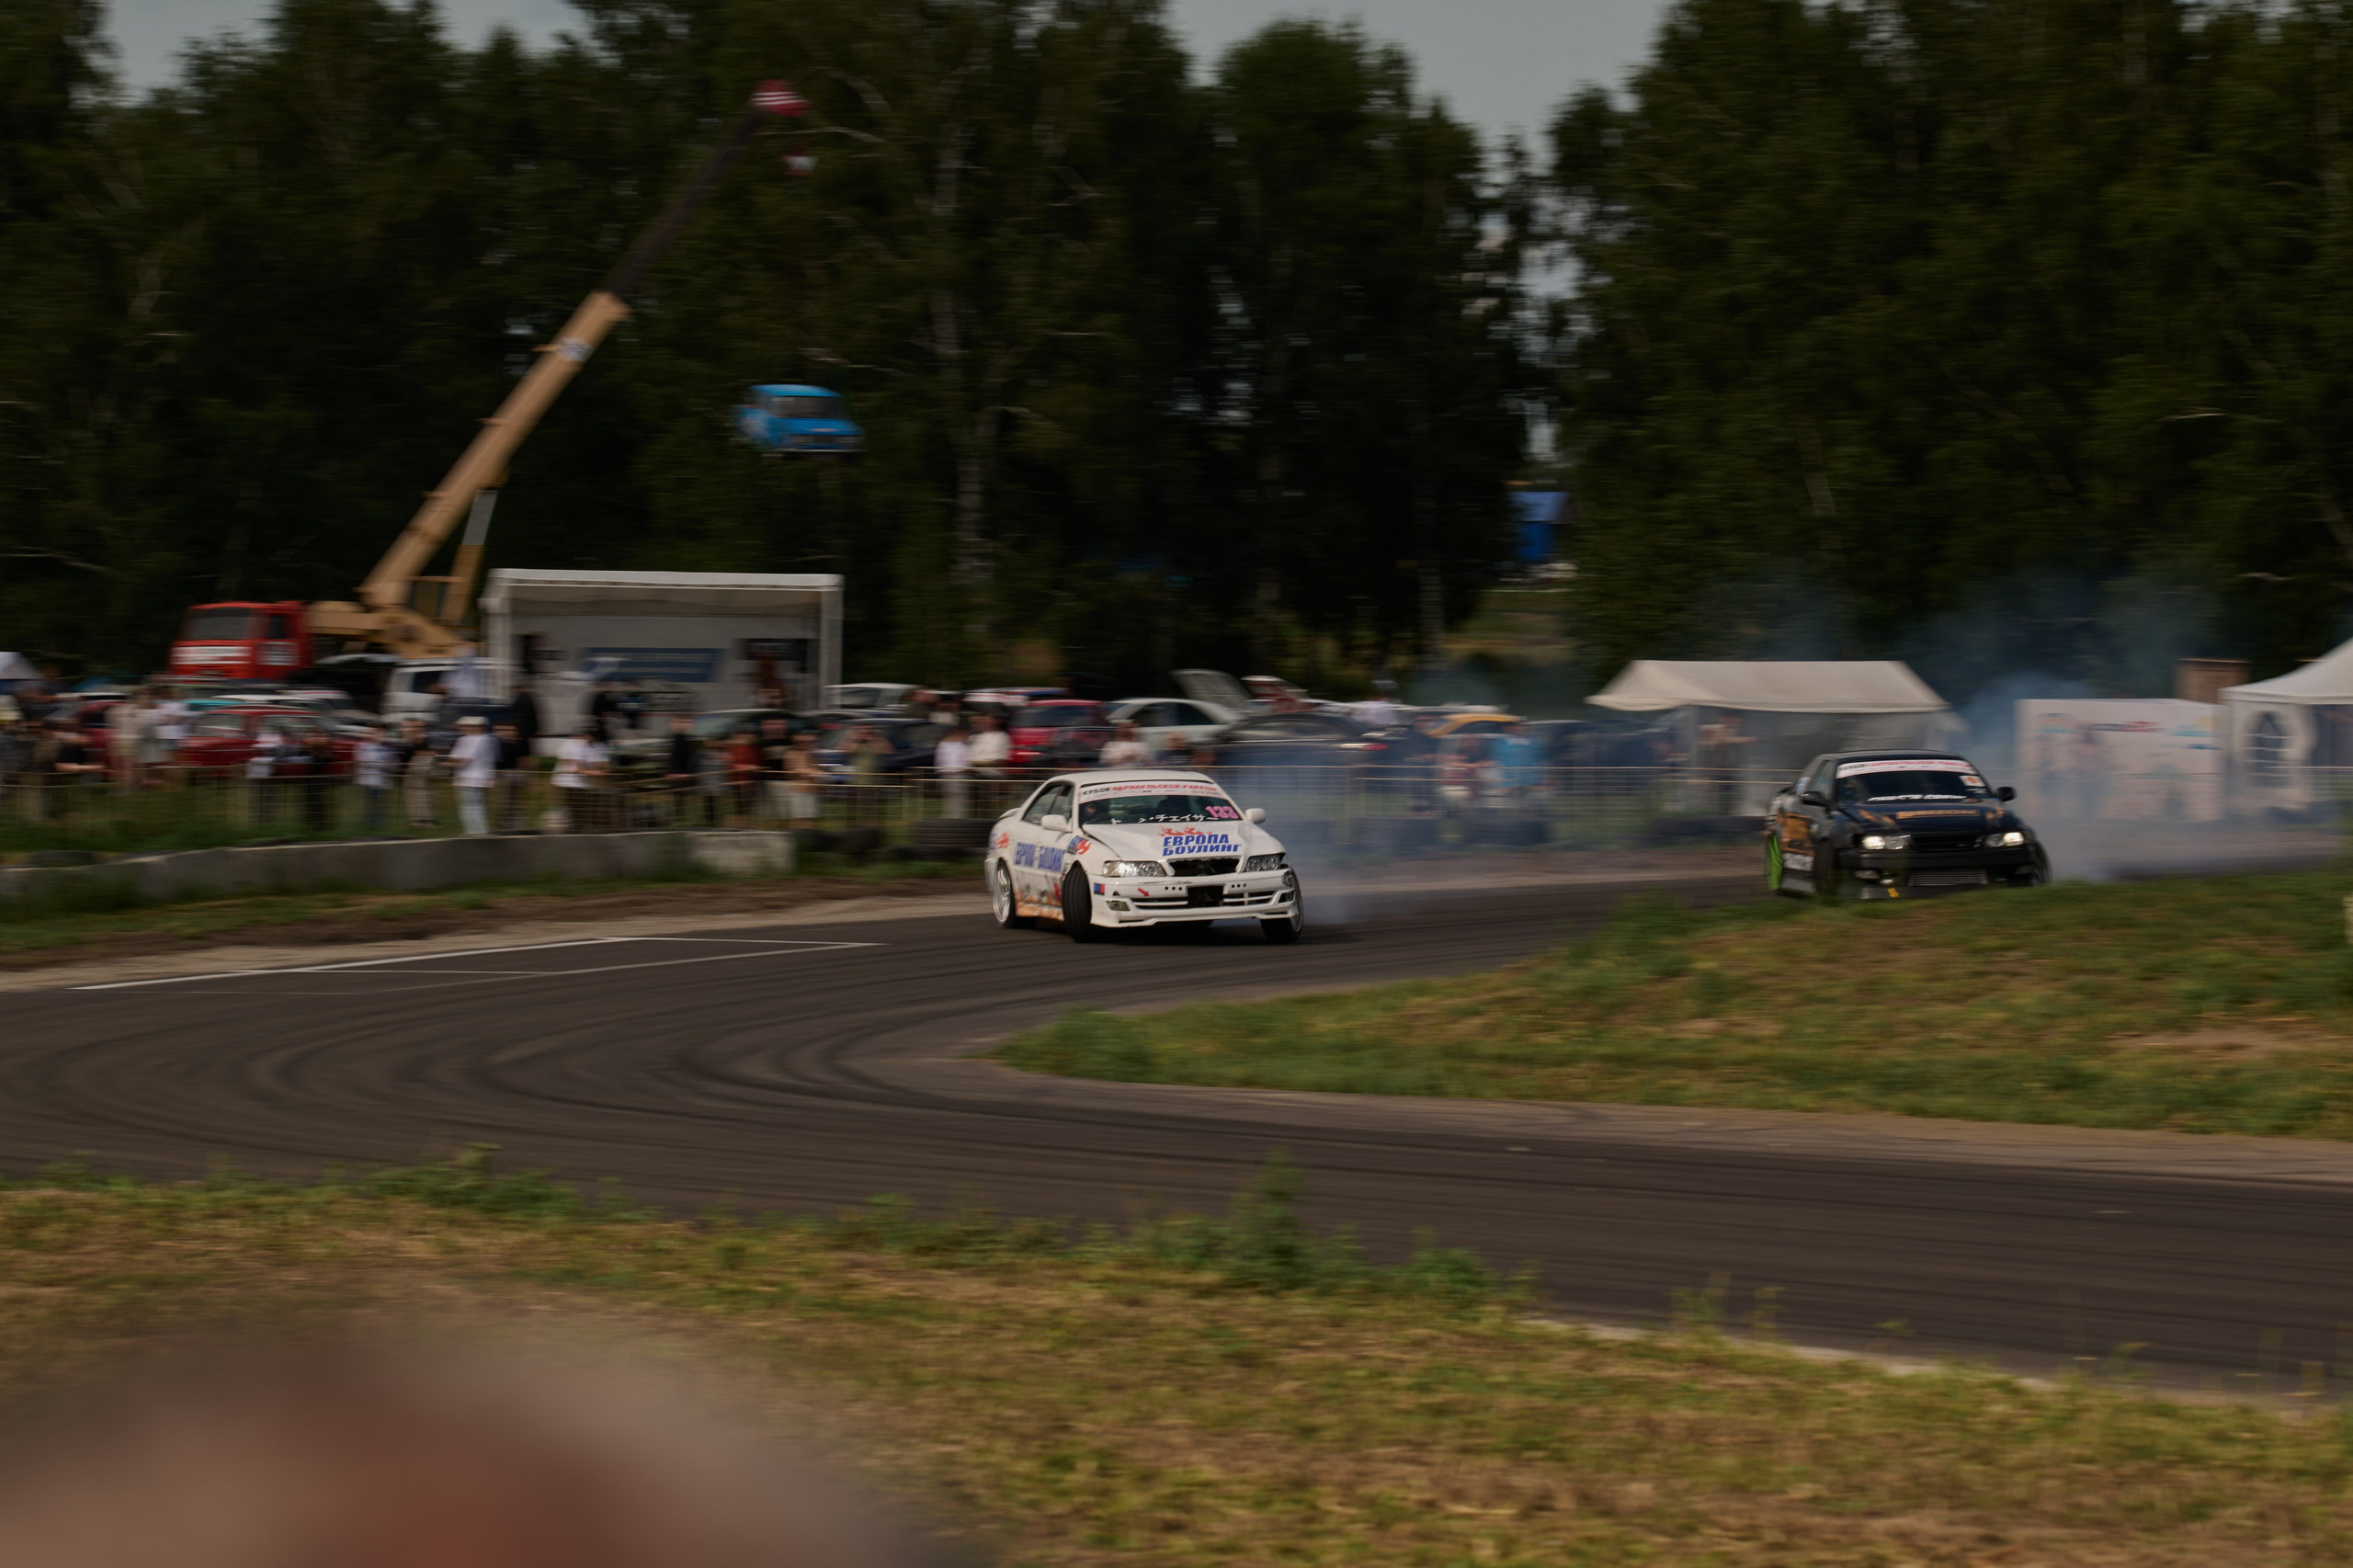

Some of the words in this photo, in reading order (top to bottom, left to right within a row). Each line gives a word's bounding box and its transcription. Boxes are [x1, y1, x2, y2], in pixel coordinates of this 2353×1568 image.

[1205, 805, 1240, 820] 133
[1163, 834, 1230, 847] ЕВРОПА
[1163, 844, 1243, 857] БОУЛИНГ
